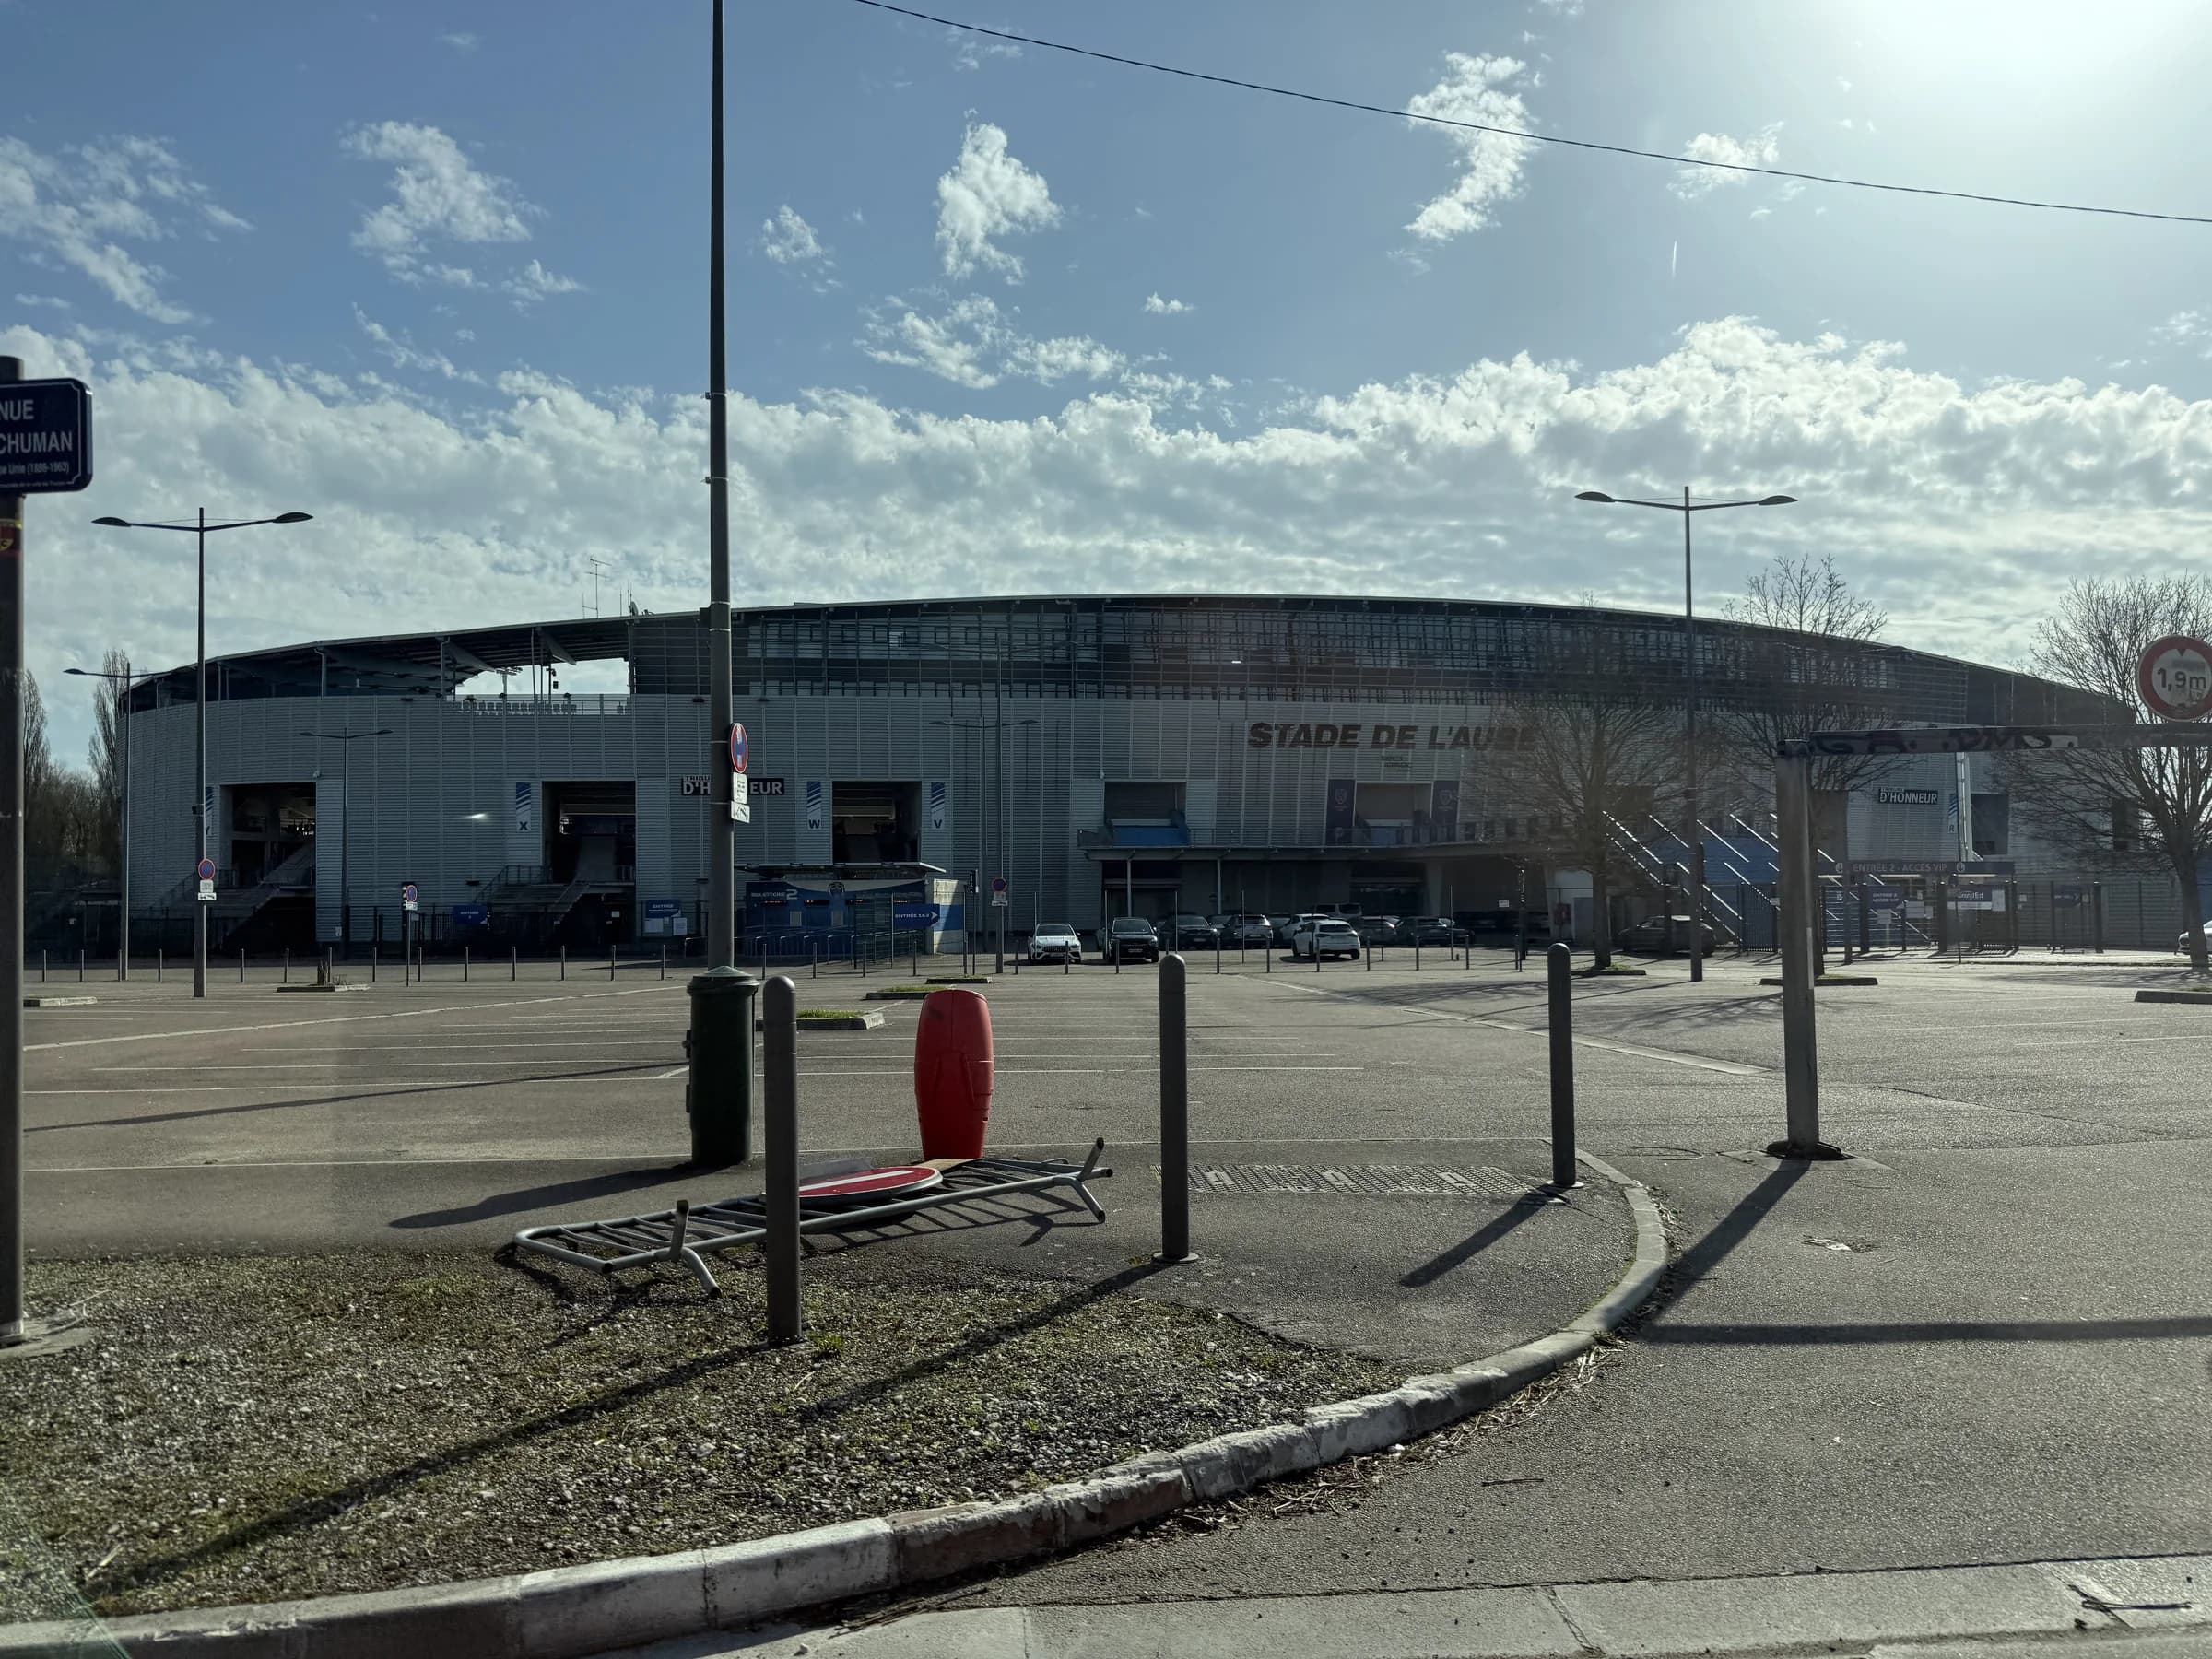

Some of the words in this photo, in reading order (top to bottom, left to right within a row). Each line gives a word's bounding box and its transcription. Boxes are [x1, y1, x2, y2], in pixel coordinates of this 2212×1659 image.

[1248, 723, 1361, 748] STADE
[1371, 724, 1419, 748] DE
[1879, 792, 1937, 804] D'HONNEUR
[519, 822, 528, 830] X
[808, 819, 820, 829] W
[934, 819, 943, 829] V
